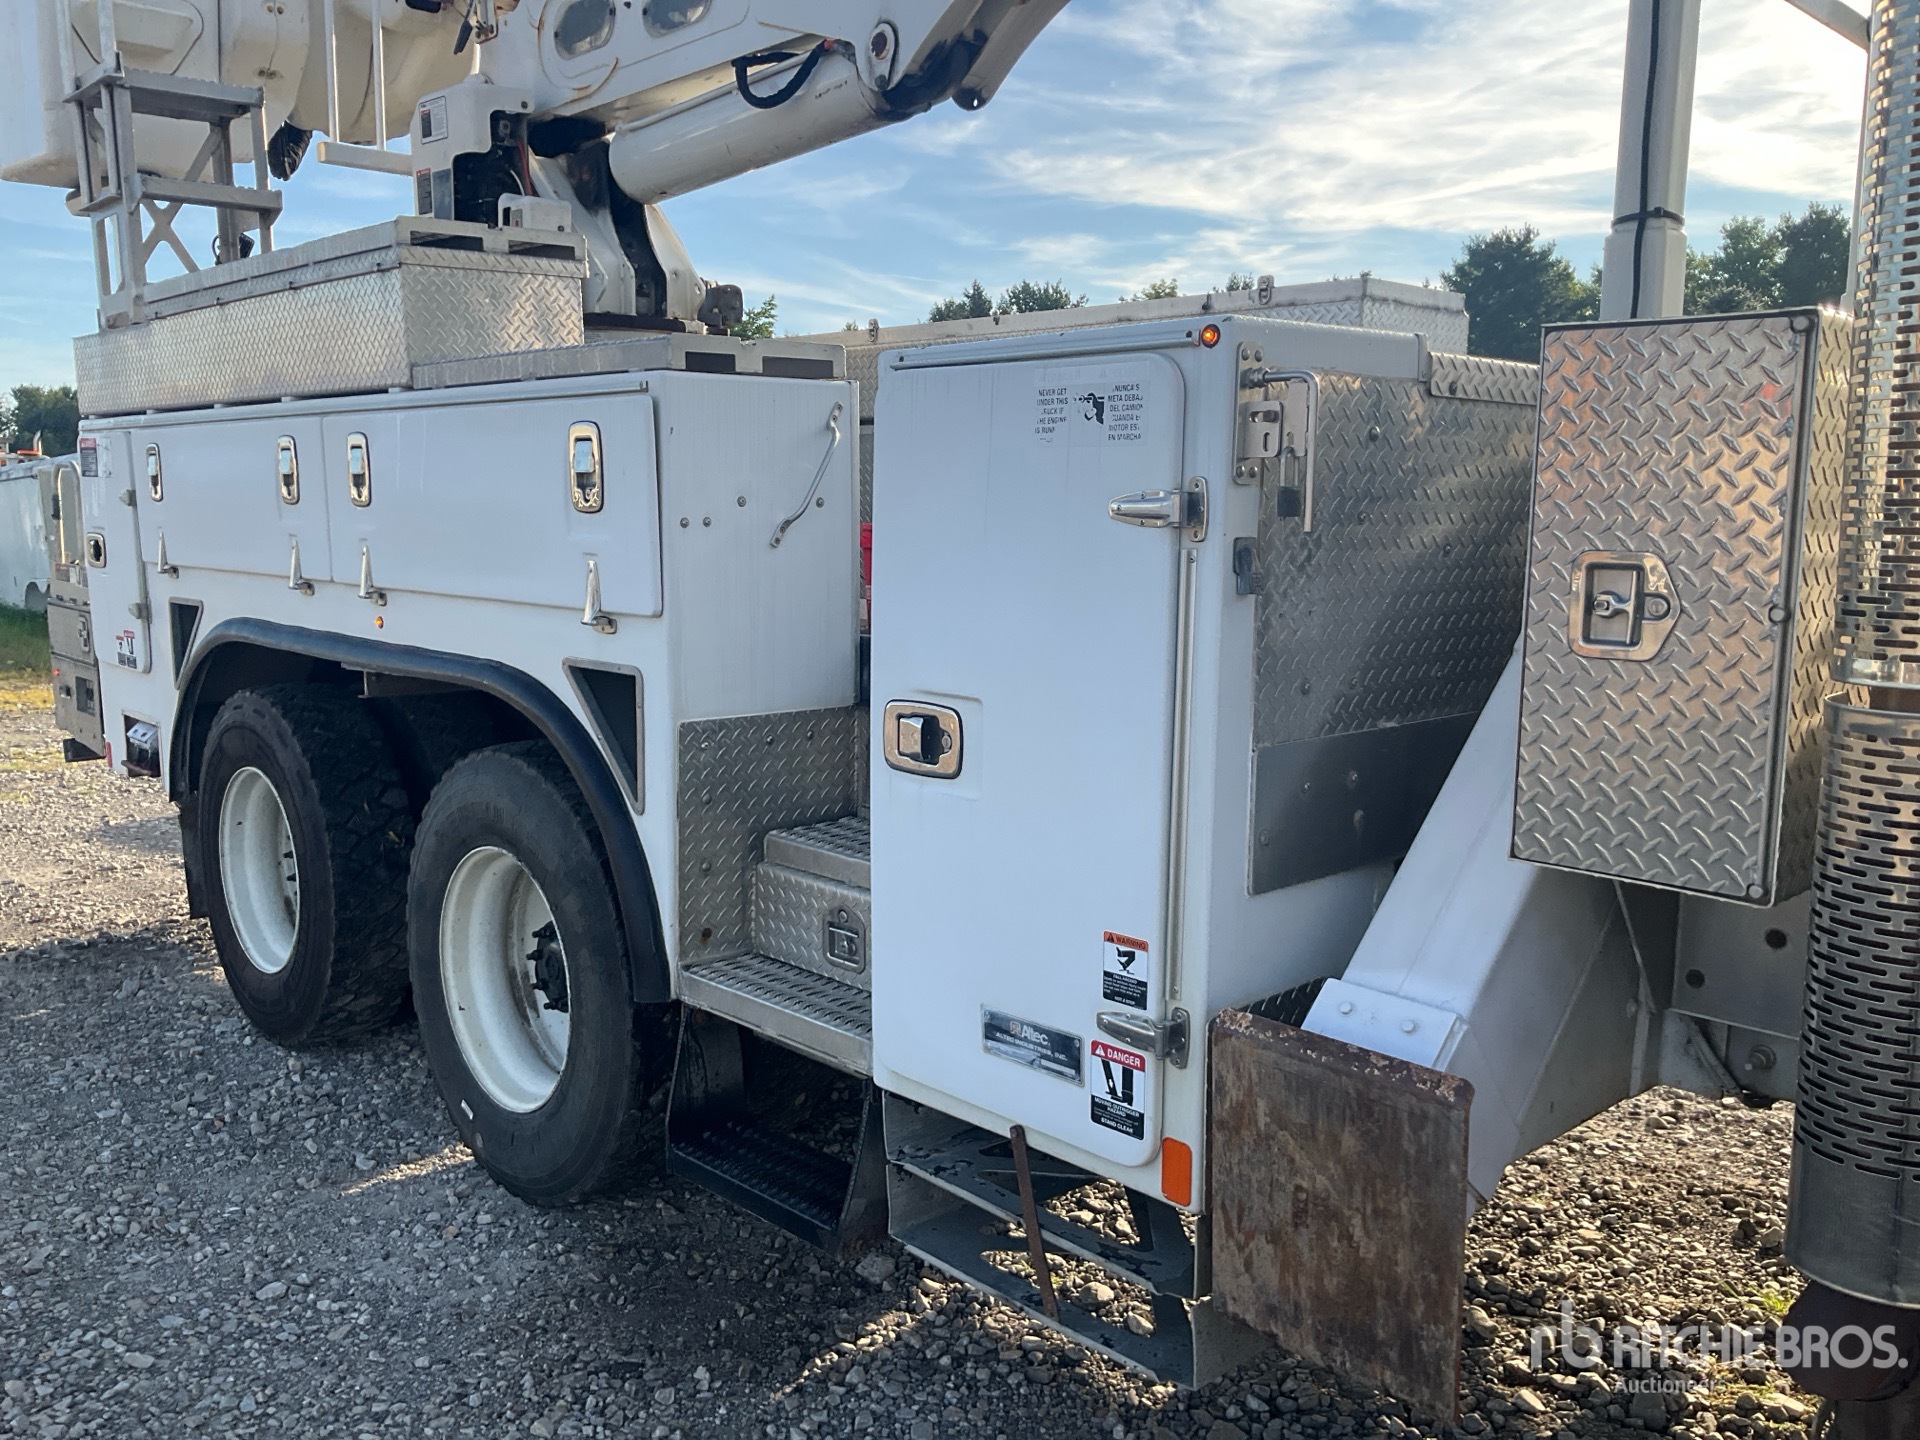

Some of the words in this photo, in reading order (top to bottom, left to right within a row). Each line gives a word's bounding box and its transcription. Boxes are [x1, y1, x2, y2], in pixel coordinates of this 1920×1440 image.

[1038, 388, 1056, 397] NEVER
[1056, 387, 1067, 396] GET
[1036, 398, 1055, 406] UNDER
[1055, 397, 1069, 405] THIS
[1107, 394, 1123, 403] META
[1041, 407, 1058, 415] RUCK
[1058, 407, 1064, 415] IF
[1109, 404, 1120, 412] DEL
[1108, 433, 1116, 441] EN
[1116, 935, 1146, 950] WARNING
[1021, 1024, 1049, 1046] Altec
[995, 1031, 1015, 1043] ALTEC
[1054, 1051, 1068, 1061] INC.
[1107, 1048, 1141, 1068] DANGER
[1094, 1096, 1112, 1107] MOVING
[1112, 1103, 1140, 1117] OUTRIGGER
[1107, 1106, 1126, 1117] HAZARD
[1100, 1117, 1117, 1128] STAND
[1117, 1123, 1134, 1133] CLEAR
